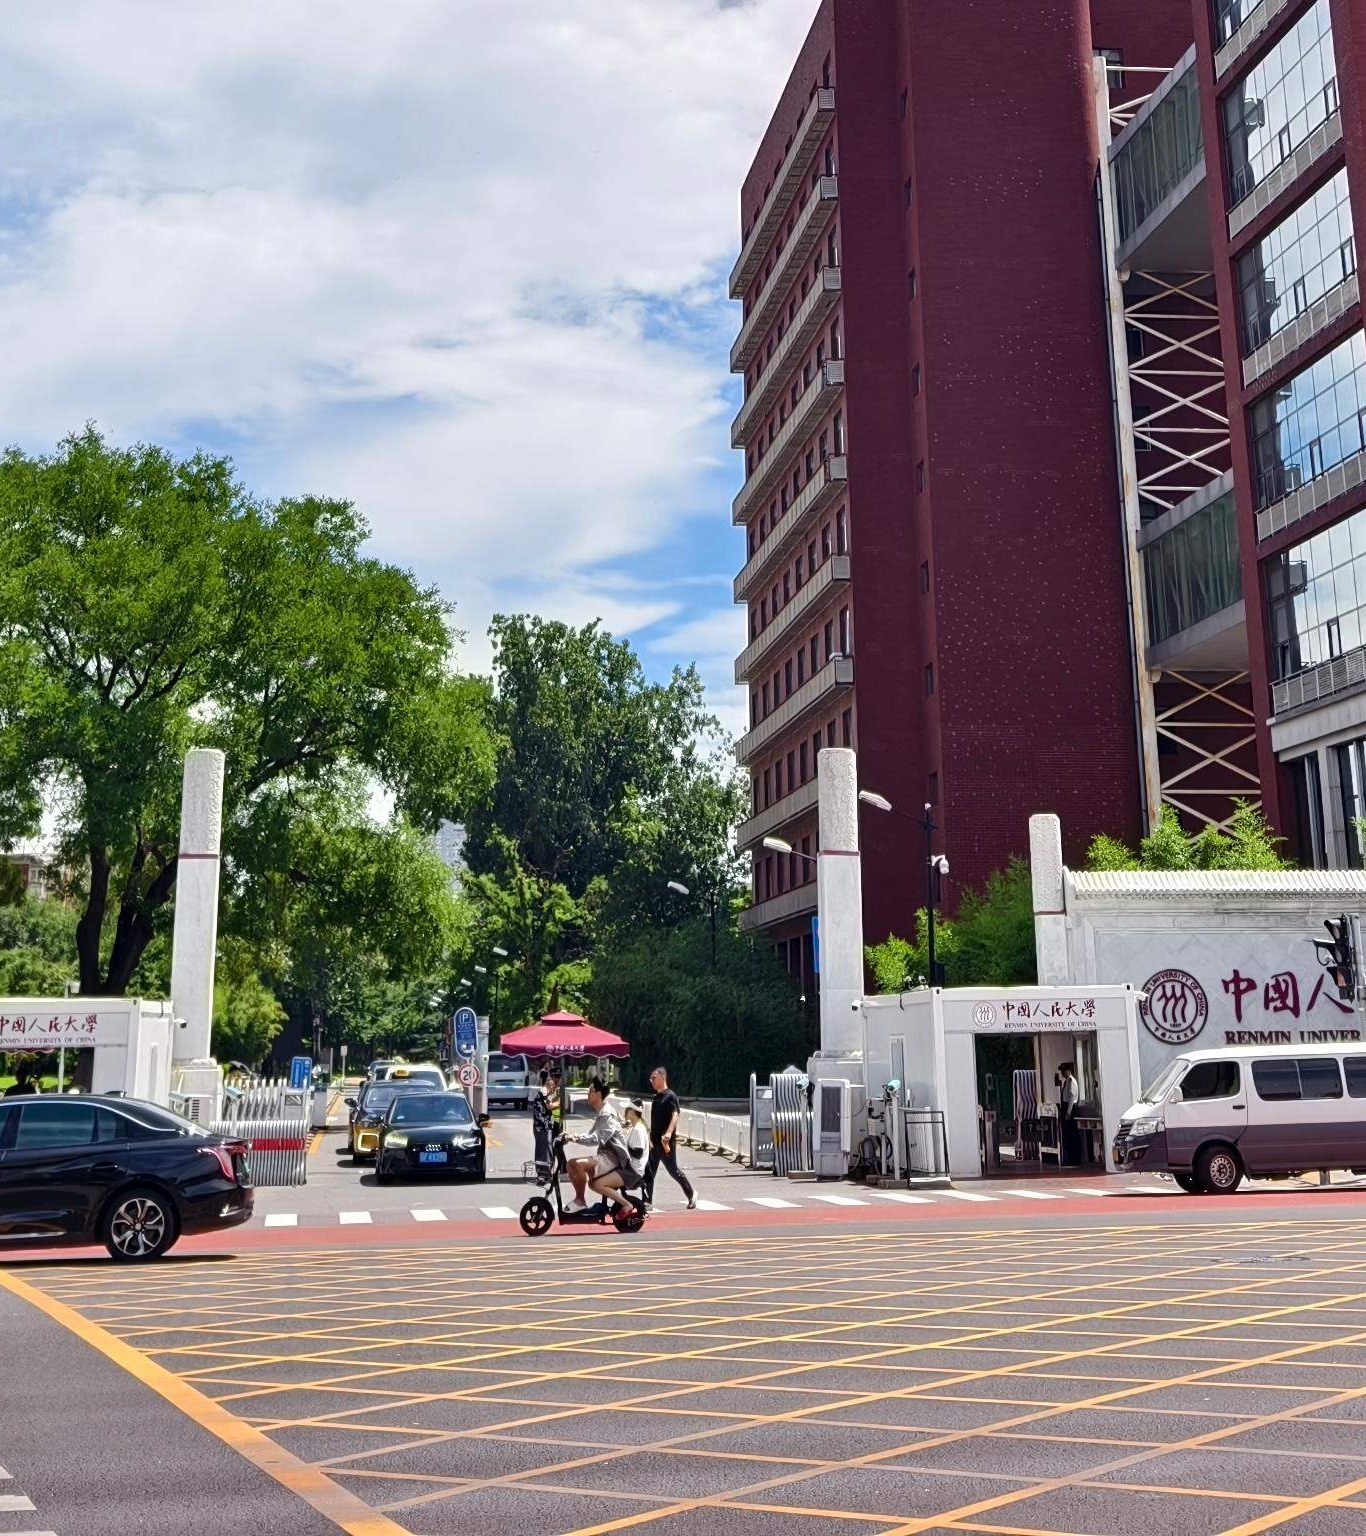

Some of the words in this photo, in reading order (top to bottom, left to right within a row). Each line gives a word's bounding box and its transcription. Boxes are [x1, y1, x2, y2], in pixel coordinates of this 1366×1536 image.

[1150, 972, 1191, 987] UNIVERSITY
[1031, 1021, 1065, 1029] UNIVERSITY
[1224, 1030, 1292, 1045] RENMIN
